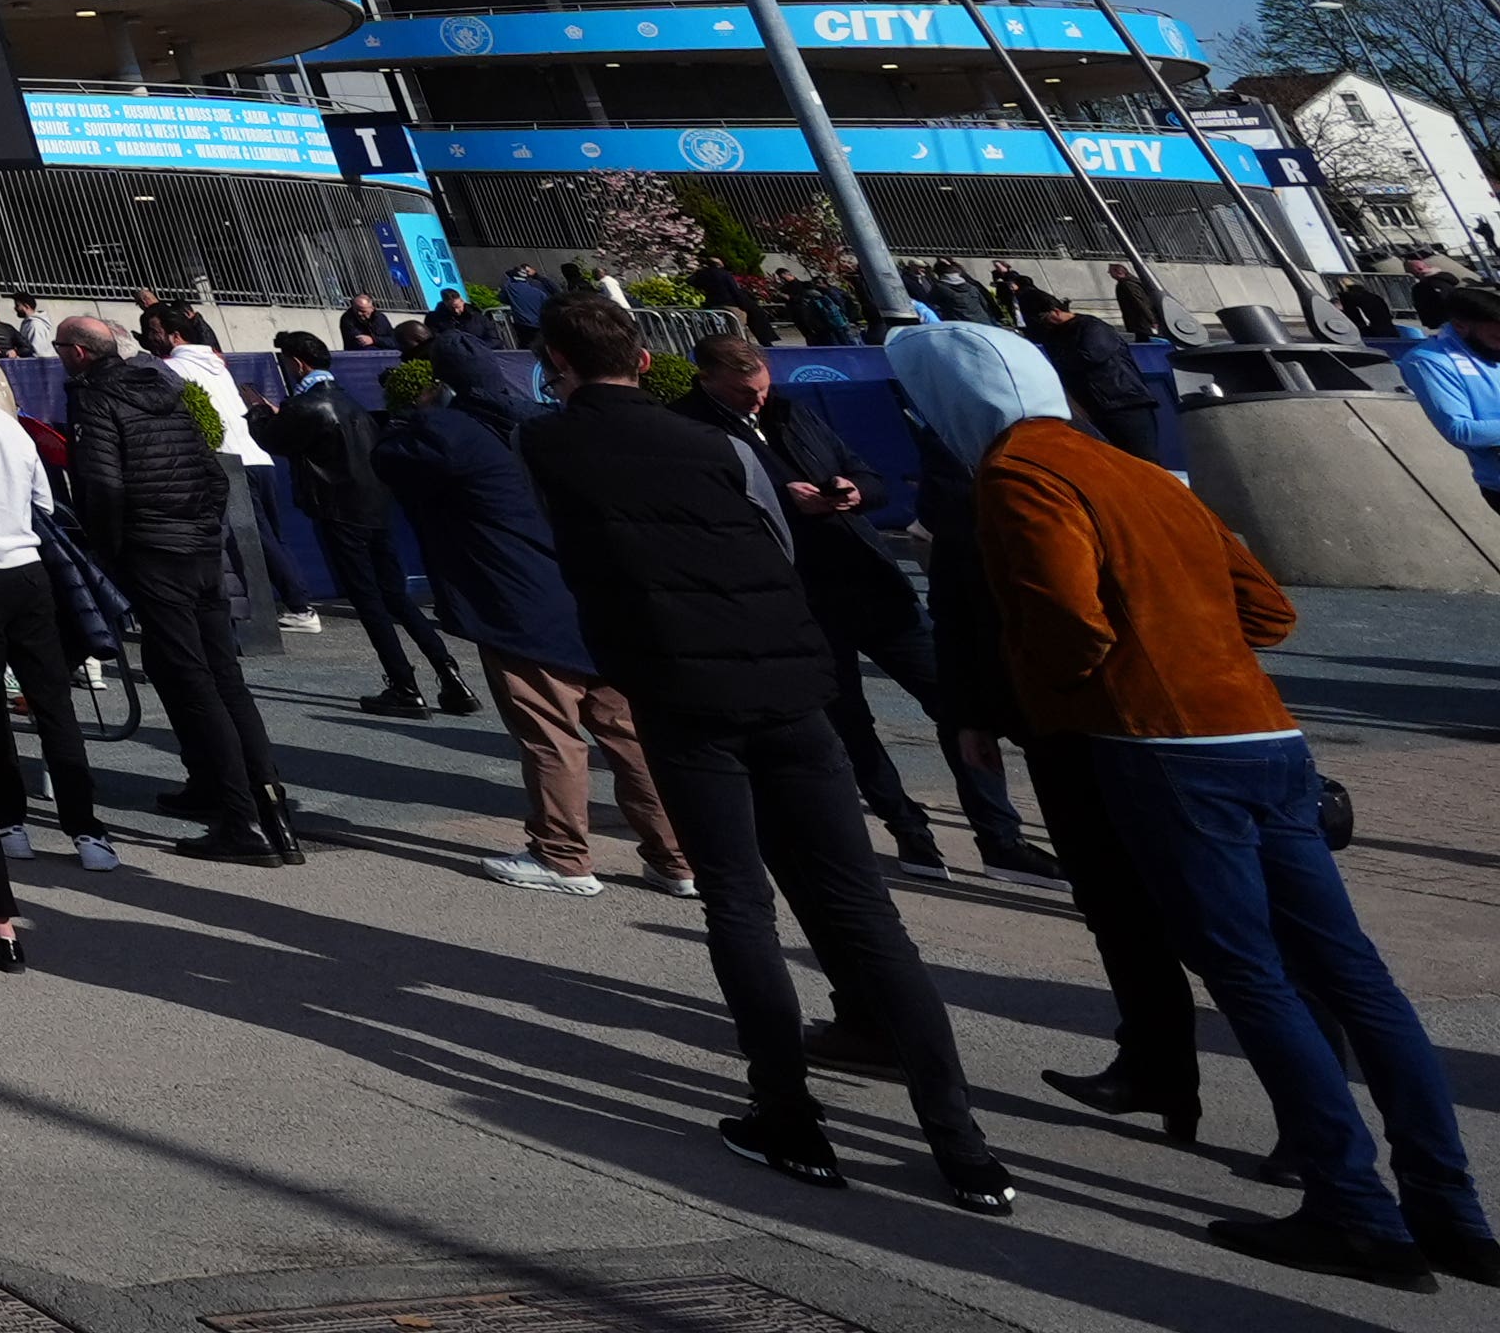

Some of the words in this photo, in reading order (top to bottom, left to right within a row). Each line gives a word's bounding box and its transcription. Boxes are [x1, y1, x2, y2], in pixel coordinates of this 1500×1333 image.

[814, 10, 934, 41] CITY
[36, 139, 101, 155] VANCOUVER
[115, 141, 184, 158] WARRINGTON
[354, 128, 383, 167] T
[1071, 138, 1162, 172] CITY
[1278, 158, 1309, 184] R
